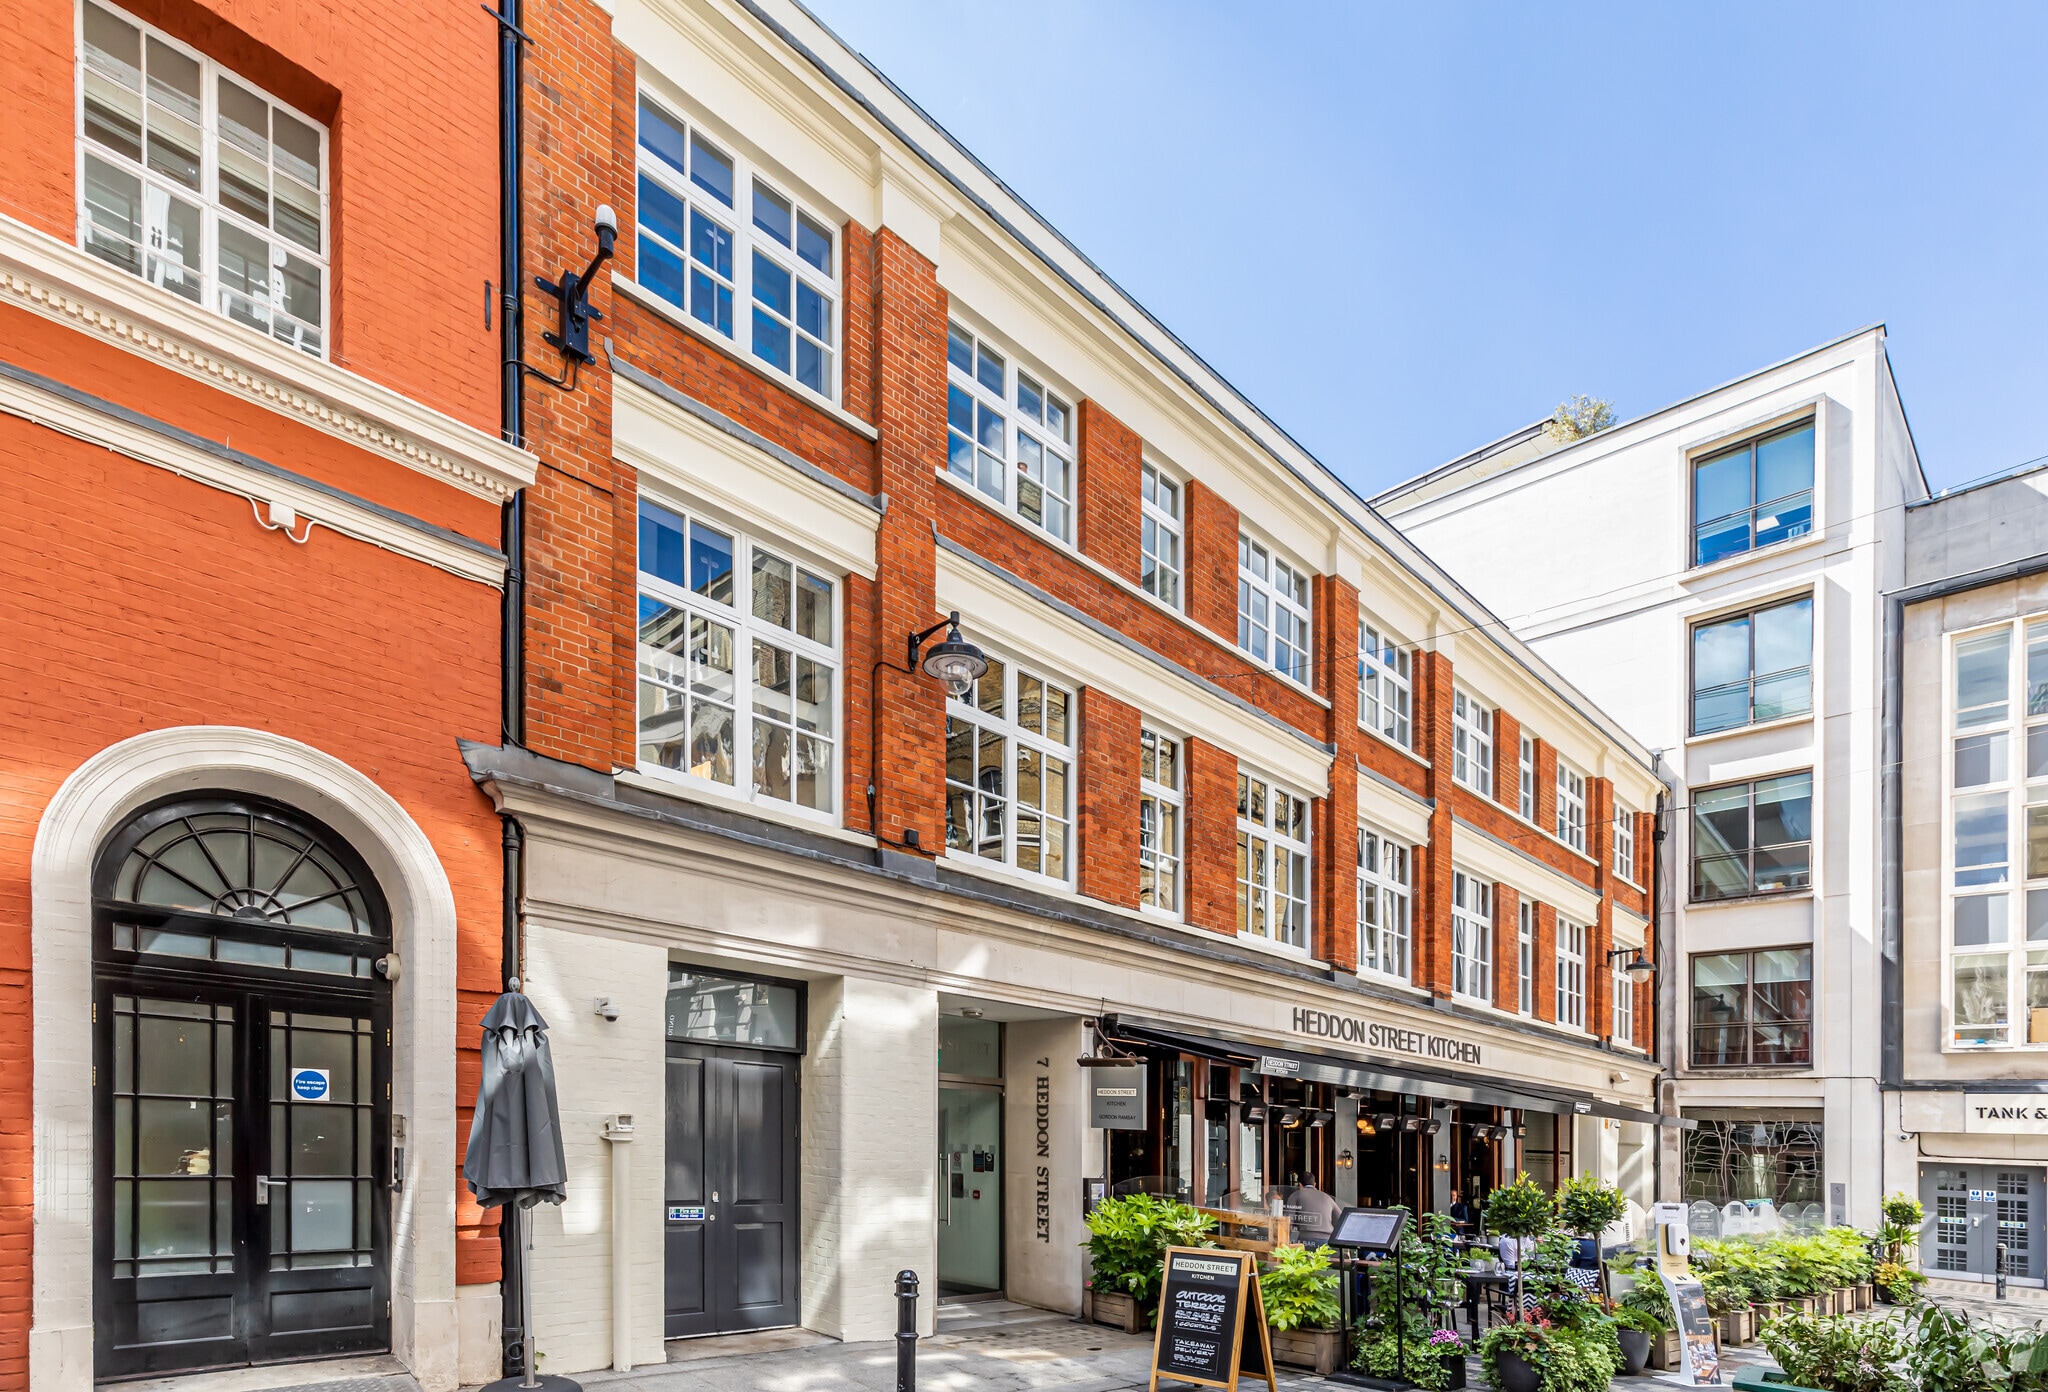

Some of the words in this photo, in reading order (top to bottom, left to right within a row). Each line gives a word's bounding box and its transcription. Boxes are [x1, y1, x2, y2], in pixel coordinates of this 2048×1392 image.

[1293, 1007, 1365, 1043] HEDDON
[1369, 1023, 1425, 1054] STREET
[1427, 1035, 1481, 1064] KITCHEN
[1037, 1057, 1050, 1068] 7
[1037, 1076, 1050, 1159] HEDDON
[1975, 1107, 2029, 1120] TANK
[2034, 1107, 2048, 1120] &
[1037, 1166, 1050, 1243] STREET
[1289, 1214, 1319, 1223] STREET
[1175, 1261, 1205, 1270] HEDDON
[1206, 1264, 1234, 1273] STREET
[1191, 1273, 1215, 1281] KITCHEN
[1175, 1290, 1226, 1303] OUTDOOR
[1175, 1300, 1225, 1313] TERRACE
[1174, 1338, 1216, 1349] TAKEAWAY
[1174, 1346, 1215, 1357] DELIVERY
